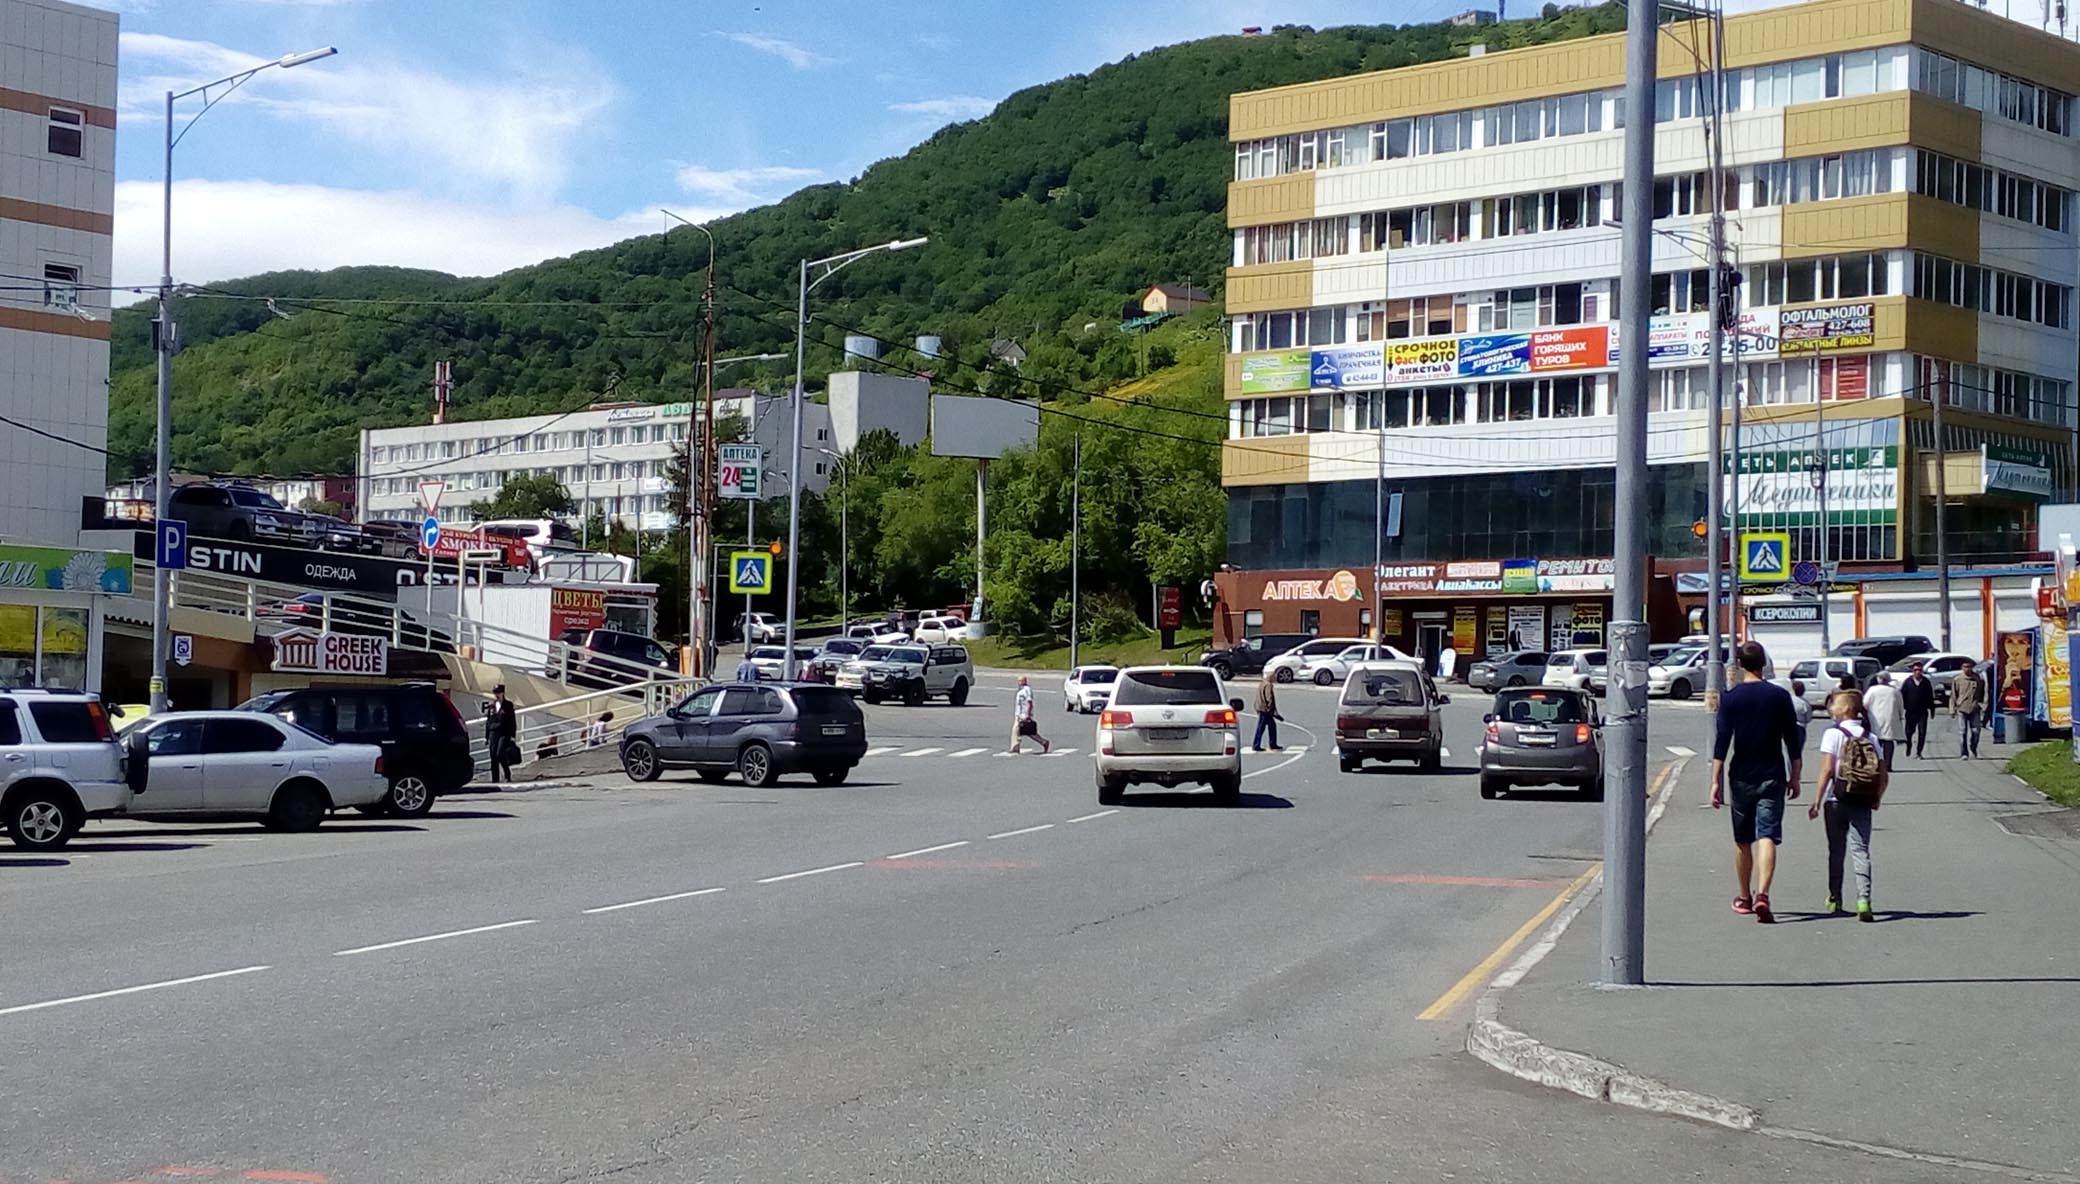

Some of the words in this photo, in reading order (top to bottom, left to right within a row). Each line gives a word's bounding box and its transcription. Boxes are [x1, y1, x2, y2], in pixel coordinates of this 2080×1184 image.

[1782, 304, 1872, 323] ОФТАЛЬМОЛОГ
[1534, 332, 1564, 343] БАНК
[1840, 335, 1872, 346] ЛИНЗЫ
[1394, 340, 1456, 353] СРОЧНОЕ
[1534, 342, 1587, 355] ГОРЯЩИХ
[1701, 337, 1776, 356] 2-25-00
[1419, 351, 1456, 364] ФОТО
[1534, 354, 1571, 366] ТУРОВ
[723, 448, 757, 459] АПТЕКА
[1727, 455, 1775, 468] СЕТЬ
[1789, 453, 1856, 467] АПЕК
[722, 466, 740, 487] 24
[304, 563, 357, 581] ОДЕЖДА
[1262, 580, 1336, 601] АПТЕКА
[553, 591, 603, 608] ЦВЕТЫ
[1754, 607, 1817, 620] КСЕРОКОПИИ
[325, 636, 382, 655] GREEK
[325, 654, 381, 672] HOUSE
